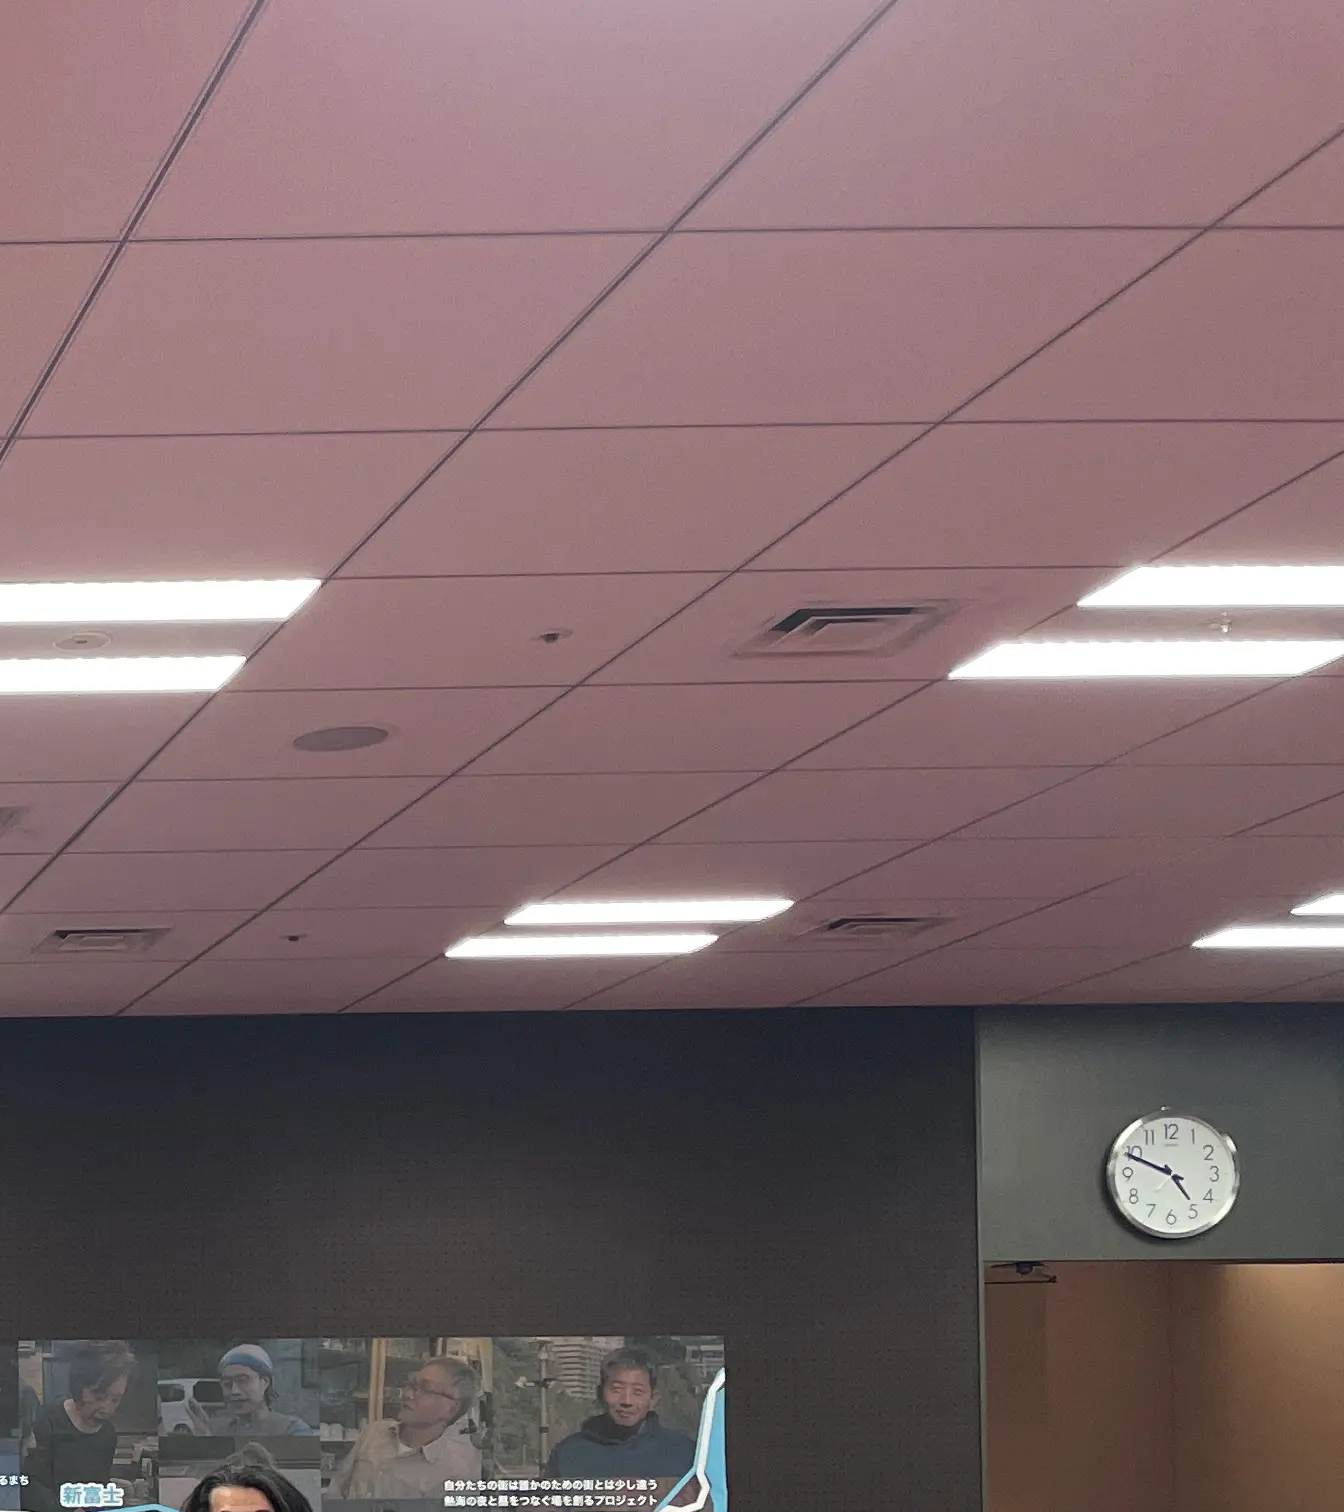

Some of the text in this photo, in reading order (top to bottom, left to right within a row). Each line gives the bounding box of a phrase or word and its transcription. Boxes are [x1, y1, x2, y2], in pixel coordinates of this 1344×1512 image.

[1145, 1129, 1155, 1145] 11
[1164, 1123, 1179, 1139] 12
[1190, 1128, 1196, 1144] 1
[1202, 1144, 1214, 1161] 2
[1122, 1166, 1134, 1181] 9
[1209, 1165, 1220, 1182] 3
[1128, 1187, 1139, 1204] 8
[1202, 1188, 1214, 1203] 4
[1145, 1203, 1157, 1218] 7
[1165, 1209, 1177, 1225] 6
[1187, 1203, 1198, 1220] 5
[62, 1484, 123, 1506] 新富士
